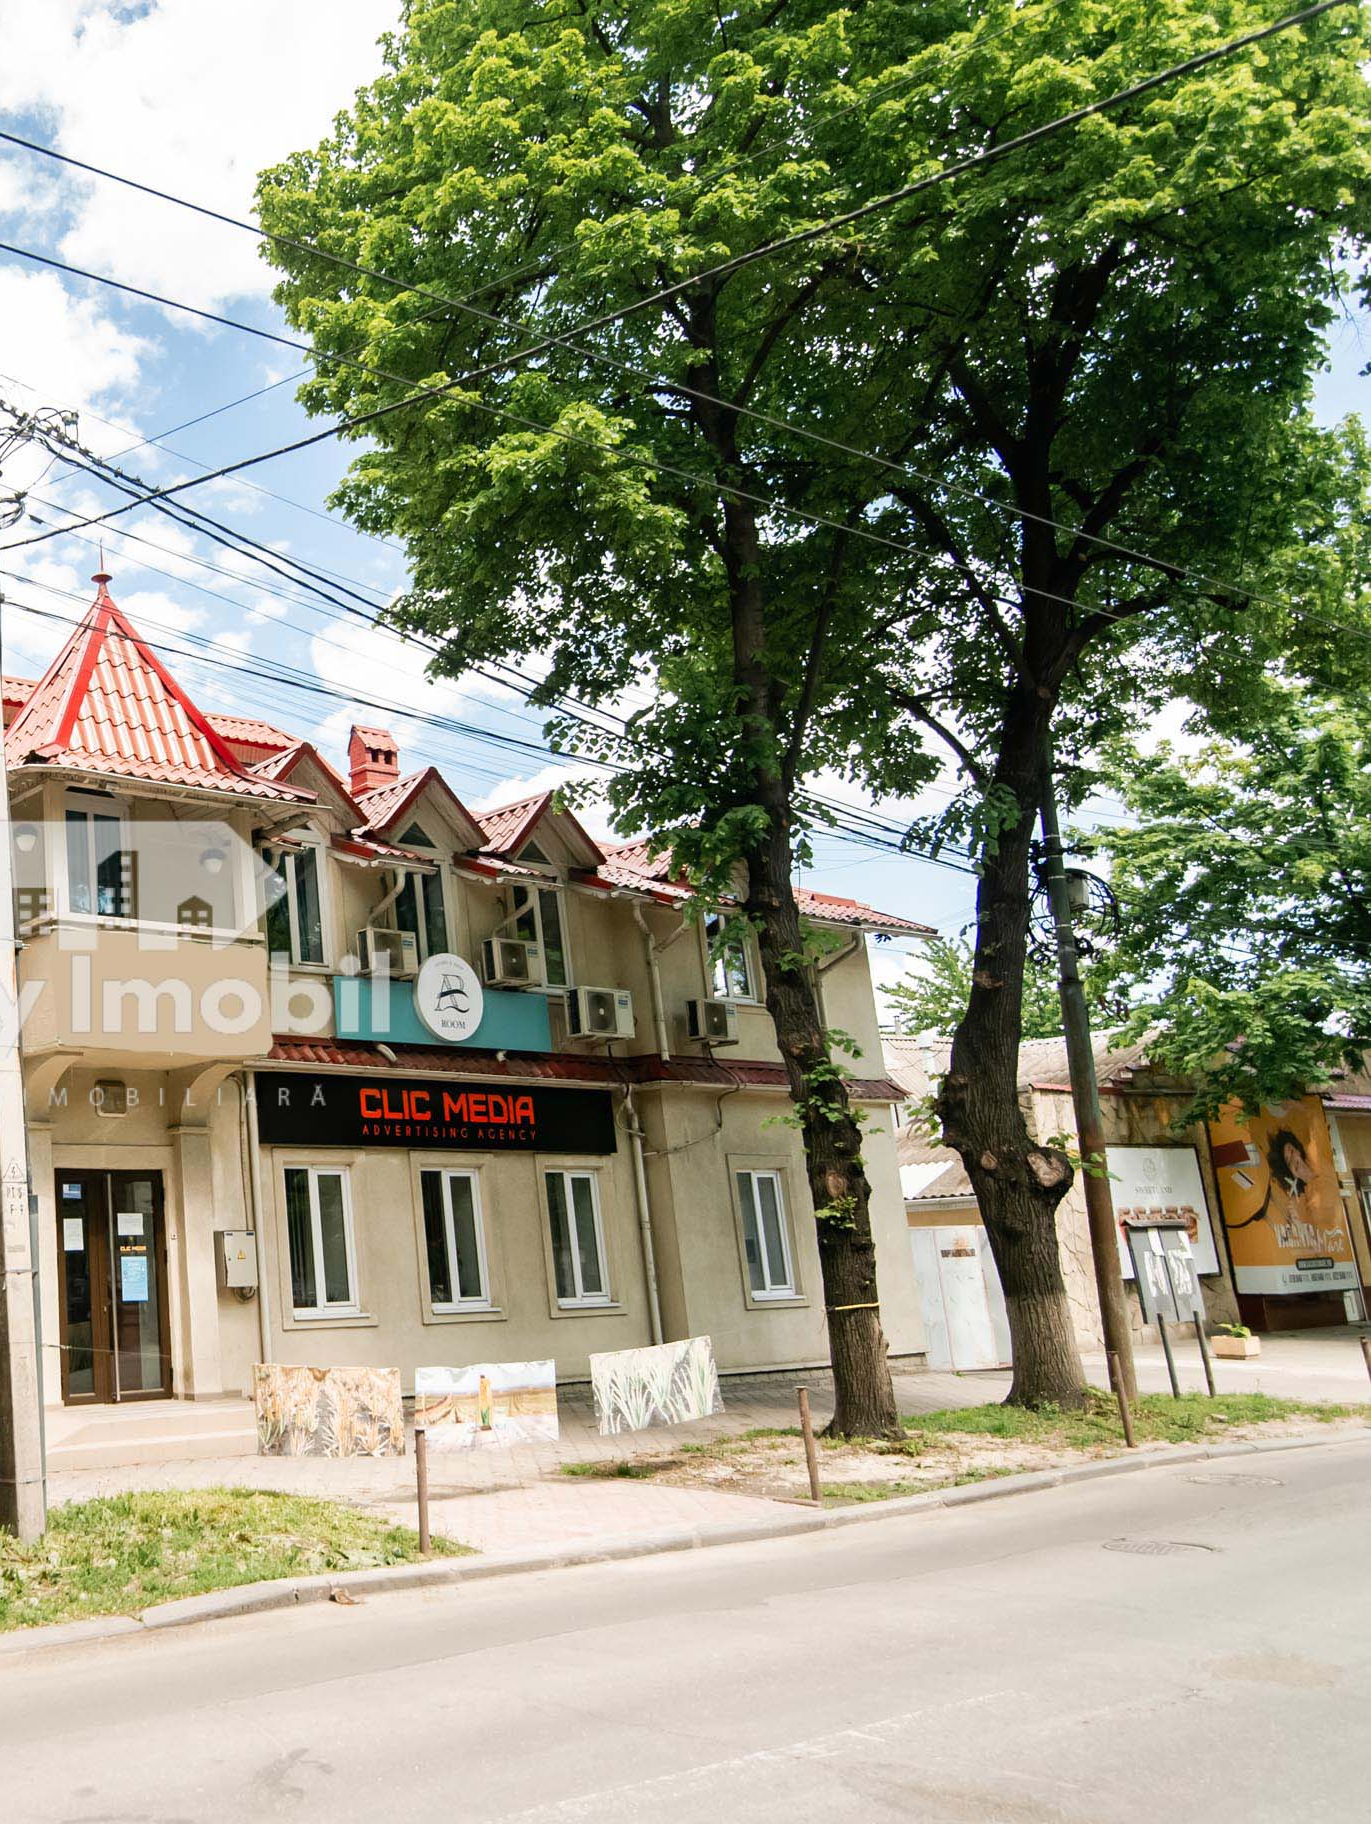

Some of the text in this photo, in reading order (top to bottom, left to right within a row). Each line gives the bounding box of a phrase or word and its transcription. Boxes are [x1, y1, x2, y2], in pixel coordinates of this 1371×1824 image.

[359, 1088, 536, 1125] CLIC MEDIA
[362, 1123, 536, 1141] ADVERTISING AGENCY
